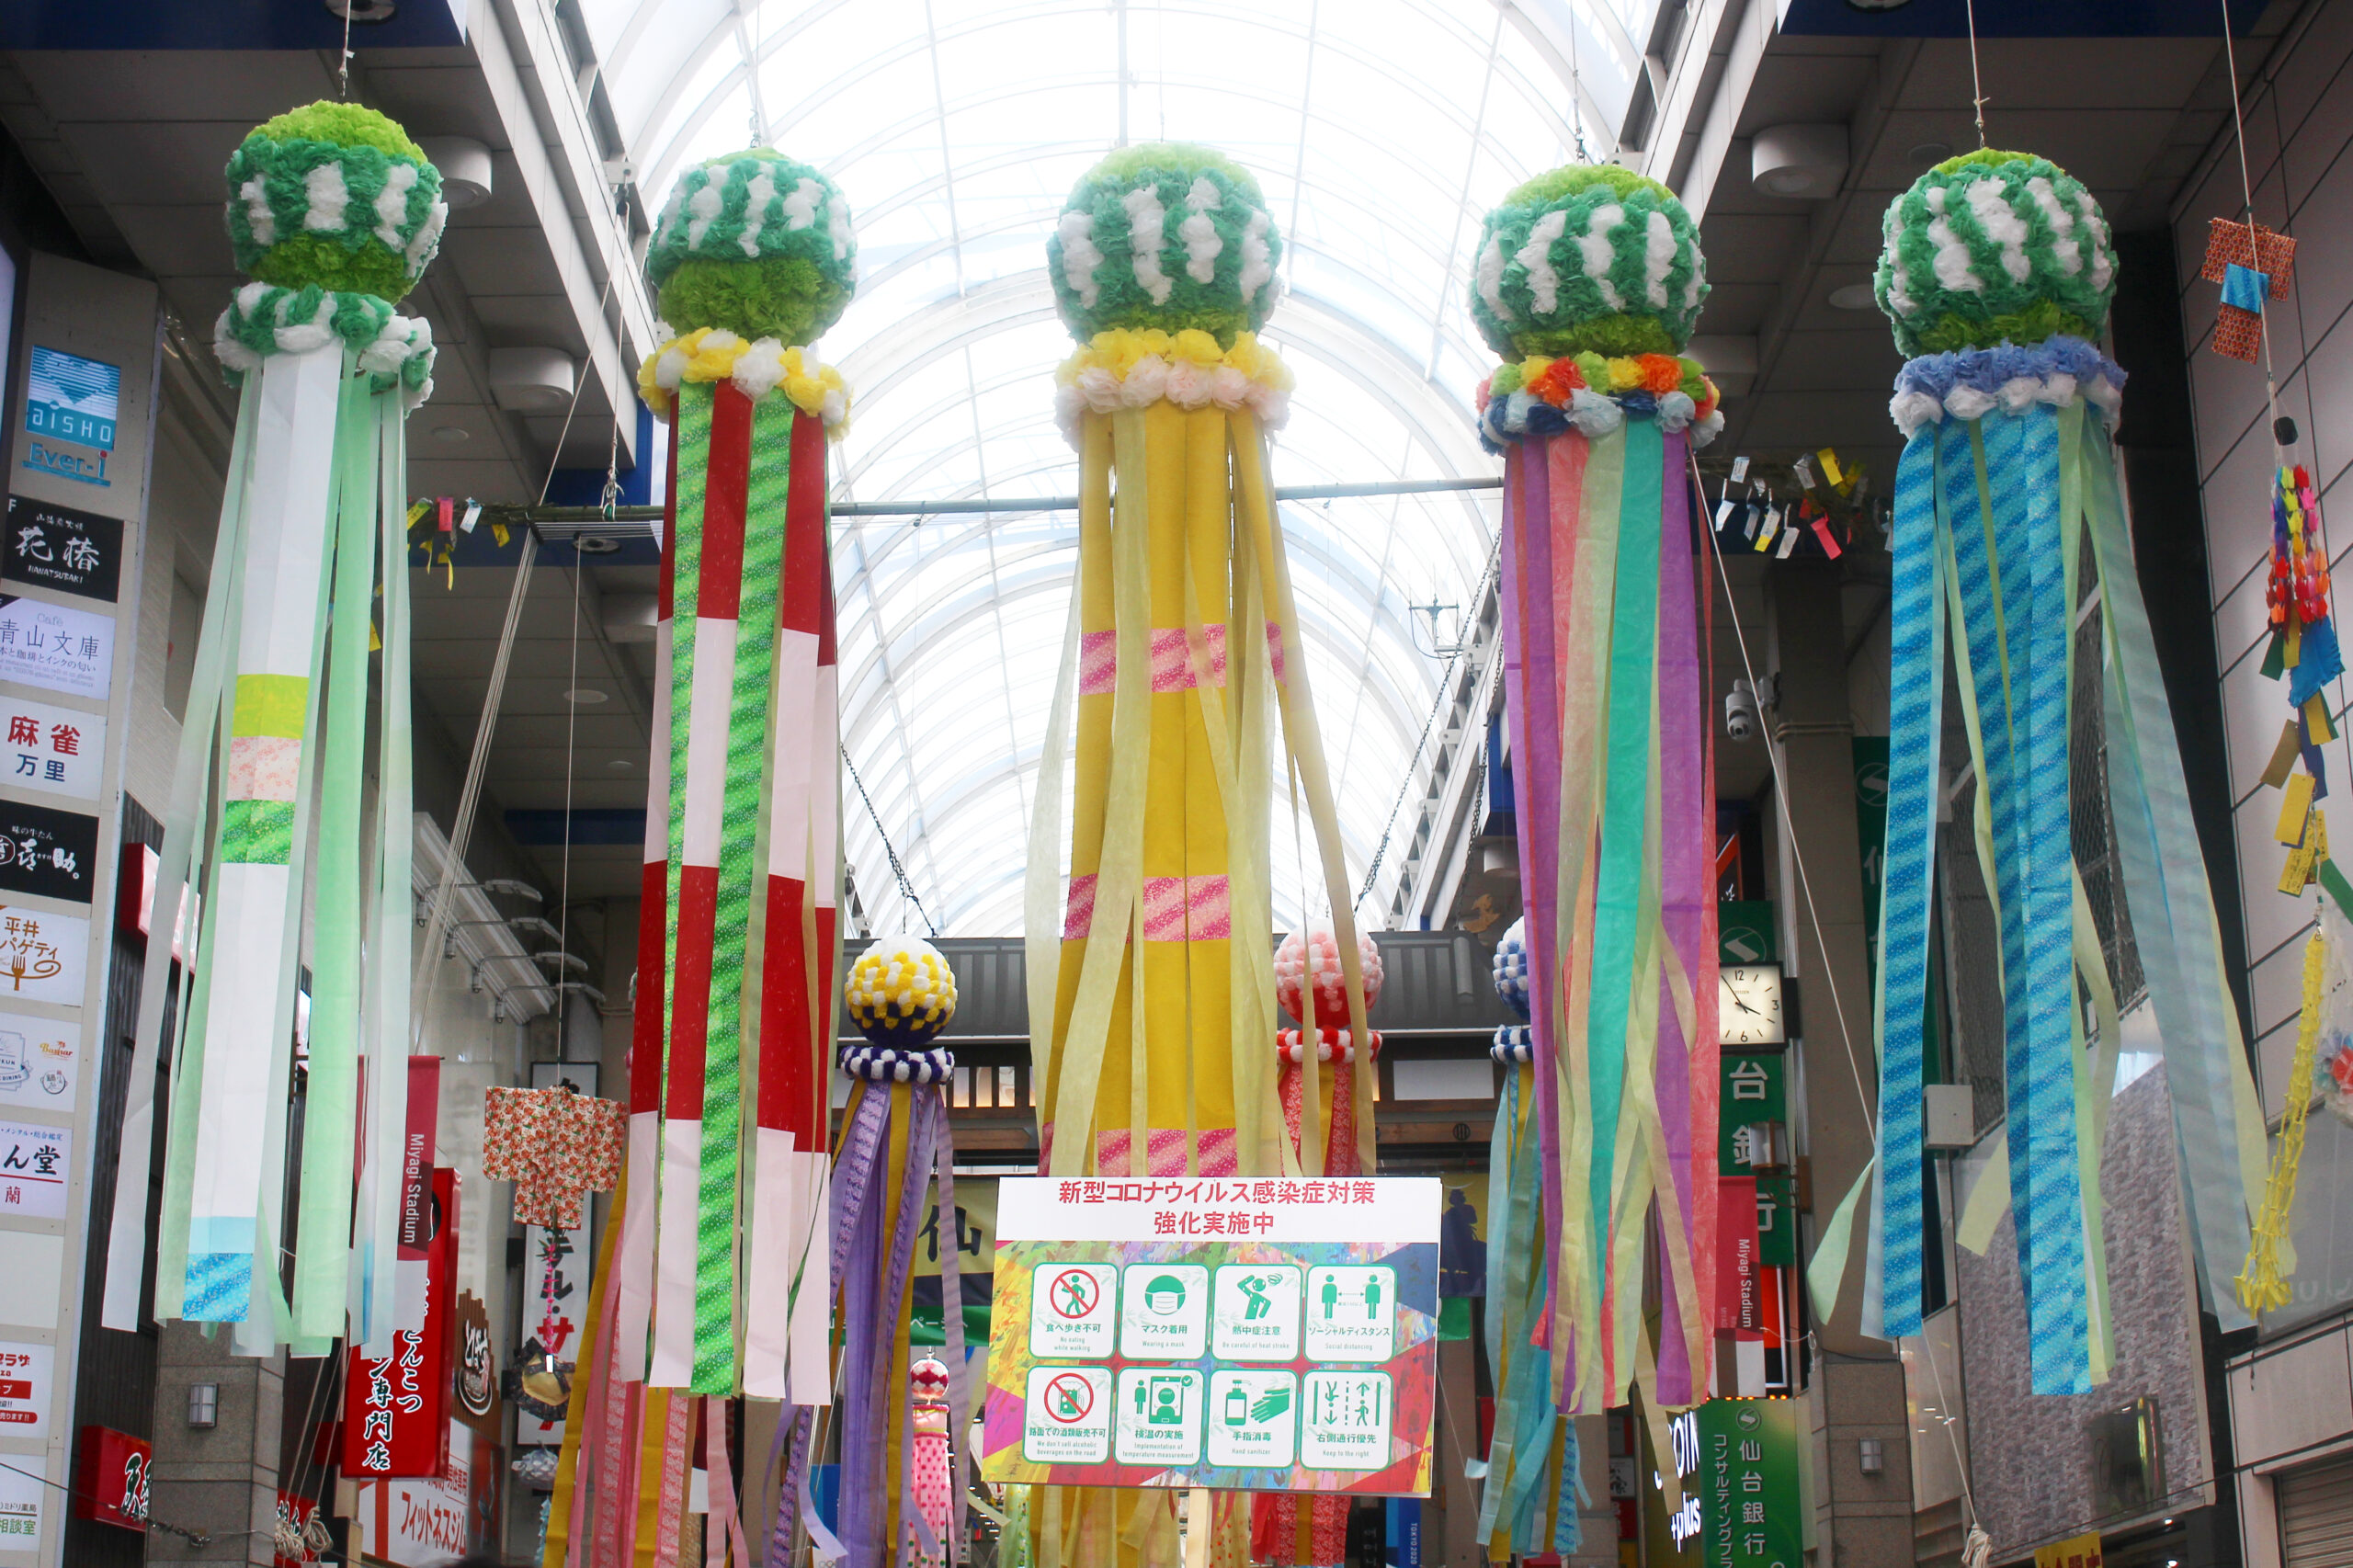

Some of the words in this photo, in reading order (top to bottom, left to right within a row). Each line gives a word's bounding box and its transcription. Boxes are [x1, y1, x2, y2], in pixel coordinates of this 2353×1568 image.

[16, 525, 100, 572] 花椿
[0, 619, 99, 661] 青山文庫
[7, 715, 81, 756] 麻雀
[16, 754, 65, 782] 万里
[5, 916, 40, 937] 平井
[1734, 970, 1745, 981] 12
[1771, 999, 1779, 1010] 3
[1740, 1030, 1748, 1042] 6
[405, 1133, 425, 1179] Miyagi
[1059, 1180, 1375, 1204] 新型コロナウイルス感染症対策
[404, 1184, 422, 1244] Stadium
[1154, 1210, 1275, 1235] 強化実施中
[1737, 1238, 1751, 1277] Miyagi
[1740, 1279, 1755, 1328] Stadium
[1046, 1324, 1101, 1334] 食べ歩き不可
[1141, 1324, 1188, 1335] マスク着用
[1232, 1325, 1281, 1335] 熱中症注意
[1309, 1326, 1391, 1336] ソーシャルディスタンス
[1142, 1340, 1165, 1348] Wearing
[1343, 1343, 1373, 1351] distancing
[1029, 1426, 1107, 1437] 路面での酒類販売不可
[1134, 1428, 1184, 1440] 検温の実施
[1233, 1431, 1272, 1442] 手指消毒
[1316, 1433, 1377, 1444] 右側通行優先
[1134, 1442, 1176, 1450] Implementation
[1122, 1450, 1155, 1459] temperature
[1739, 1439, 1766, 1555] 仙台銀行
[401, 1491, 467, 1556] フィットネスジム
